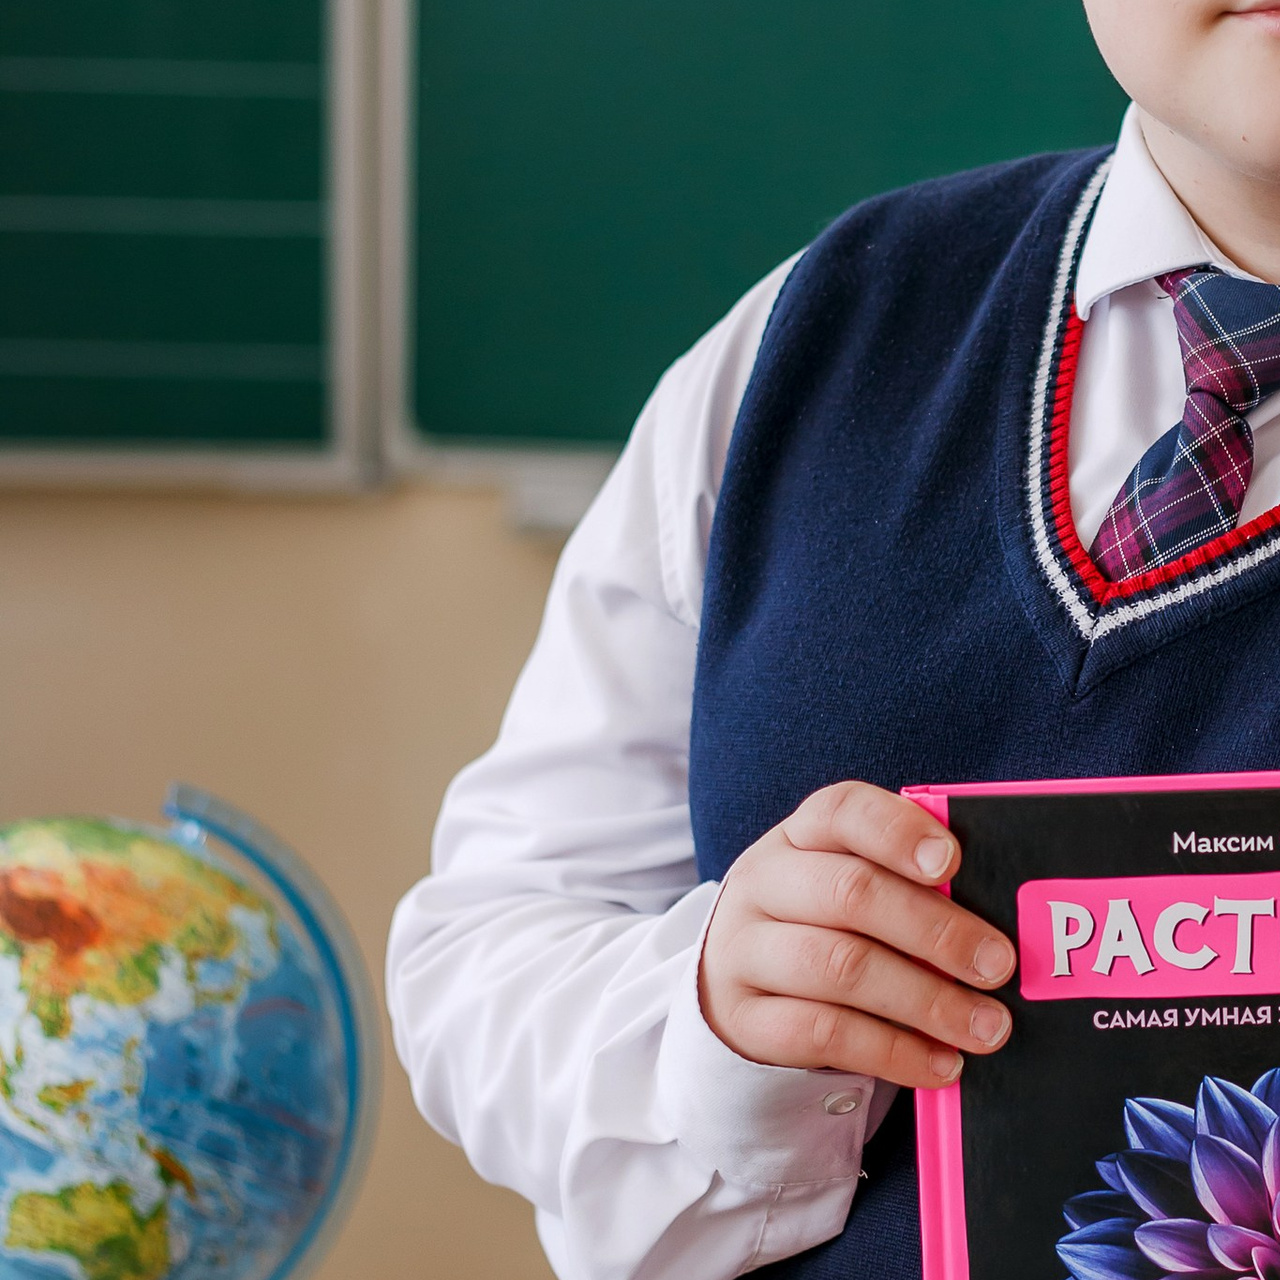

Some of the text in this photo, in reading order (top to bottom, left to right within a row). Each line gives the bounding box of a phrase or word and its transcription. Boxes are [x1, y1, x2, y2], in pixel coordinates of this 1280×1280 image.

[1172, 831, 1274, 854] Максим
[1093, 1008, 1179, 1029] САМАЯ
[1184, 1005, 1272, 1026] УМНАЯ
